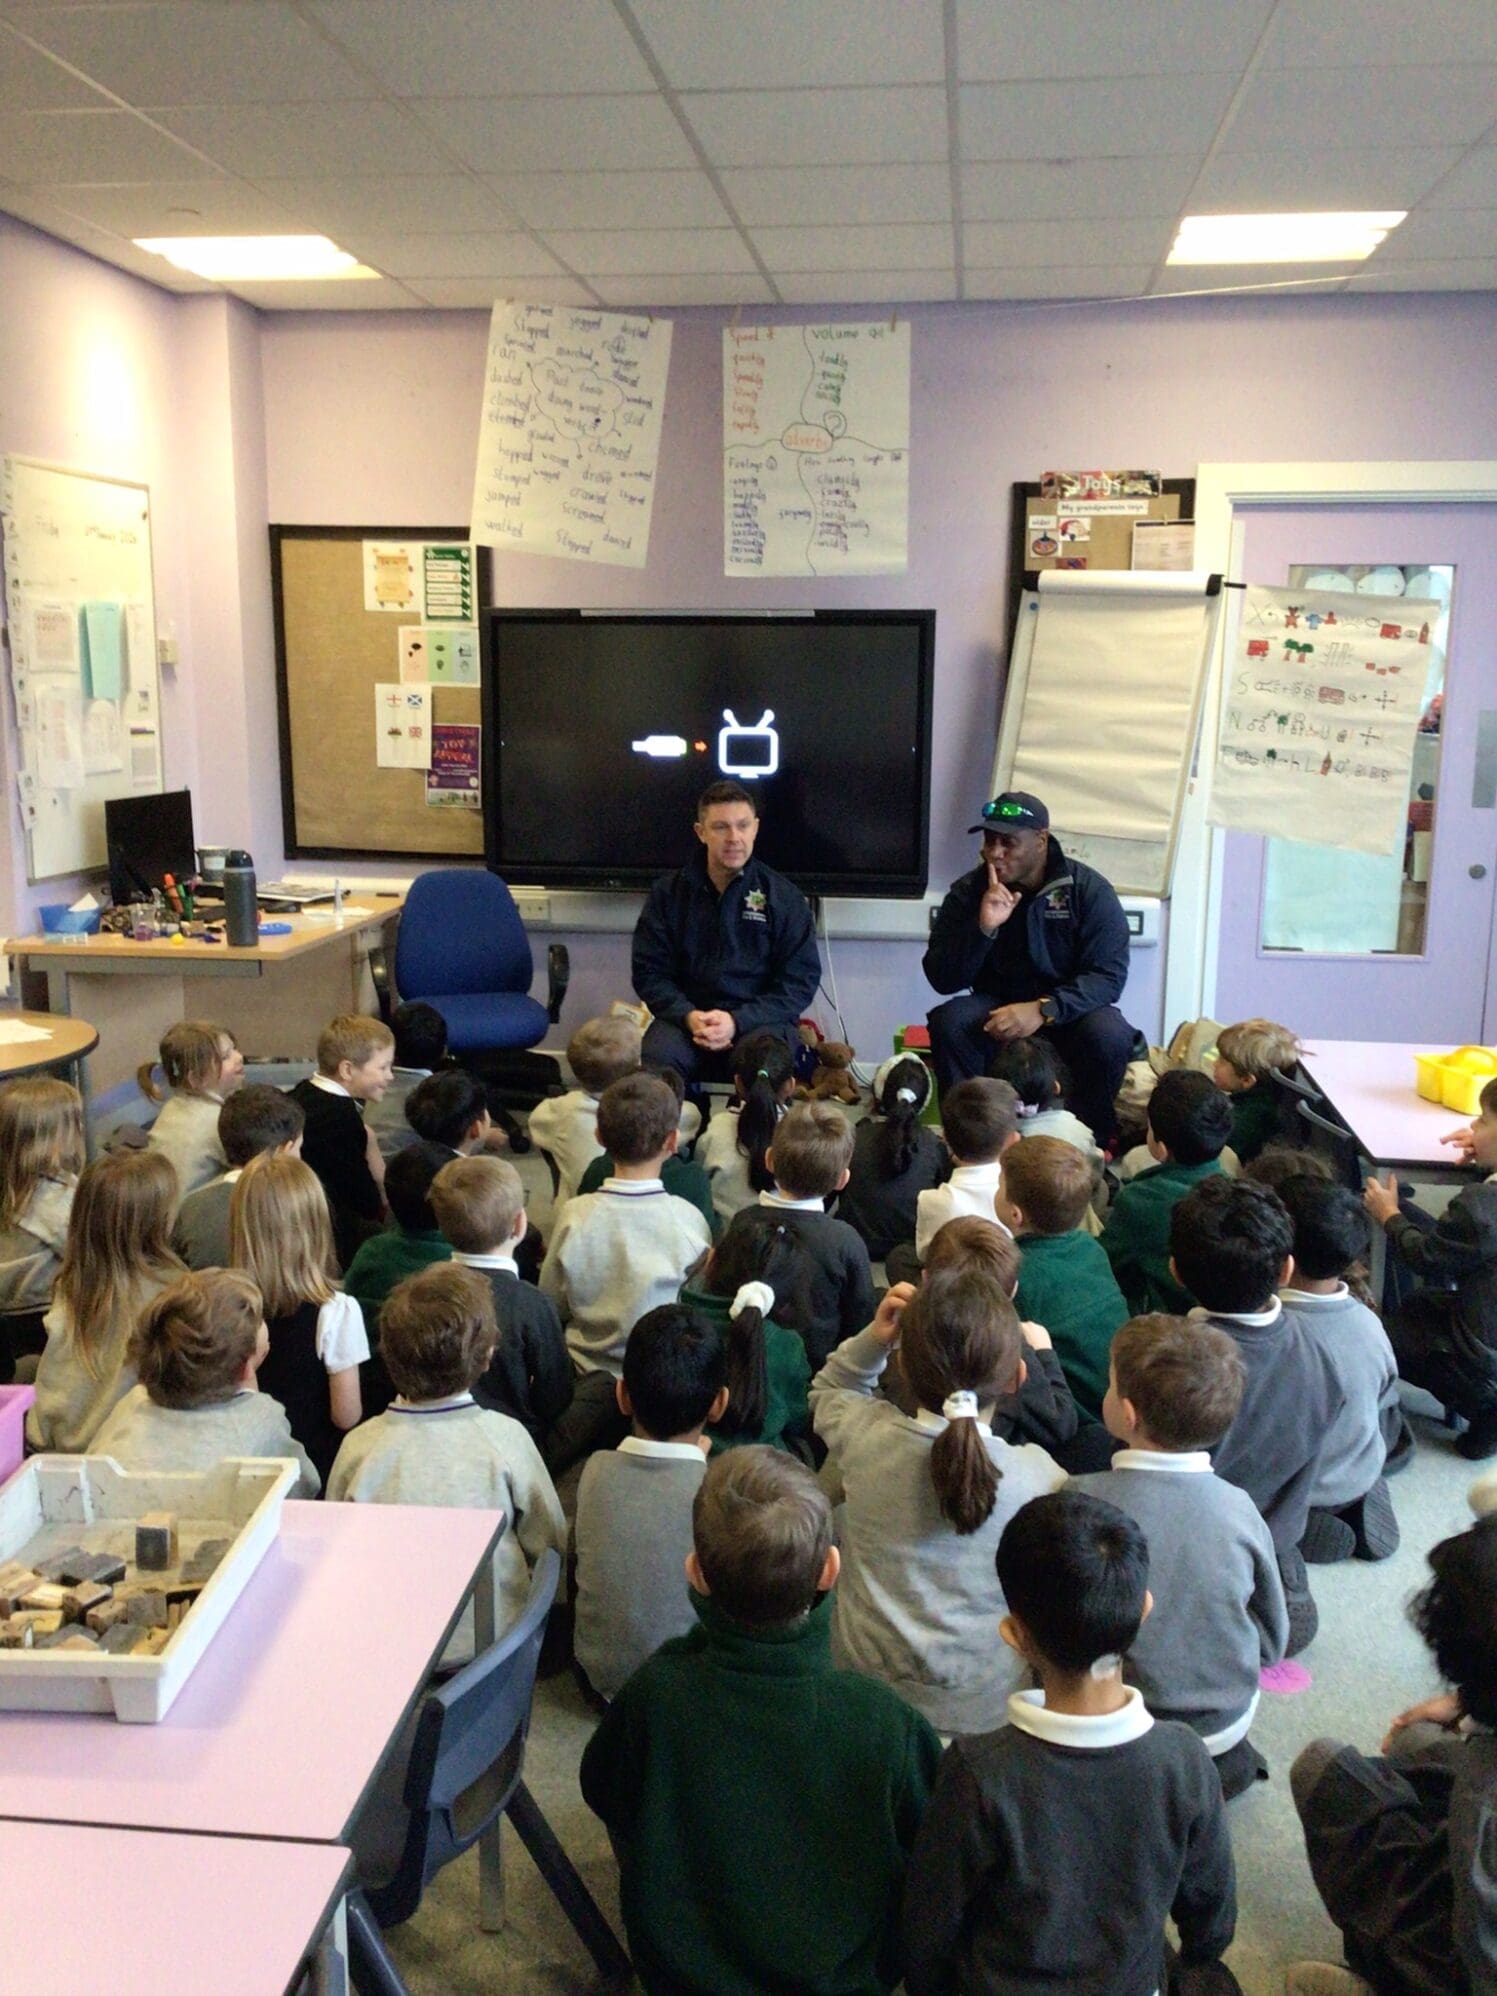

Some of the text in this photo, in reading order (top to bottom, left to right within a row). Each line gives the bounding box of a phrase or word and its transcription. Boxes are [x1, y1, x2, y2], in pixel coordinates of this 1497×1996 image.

[493, 345, 516, 360] ran
[1082, 474, 1121, 497] Toys
[485, 518, 524, 538] walked
